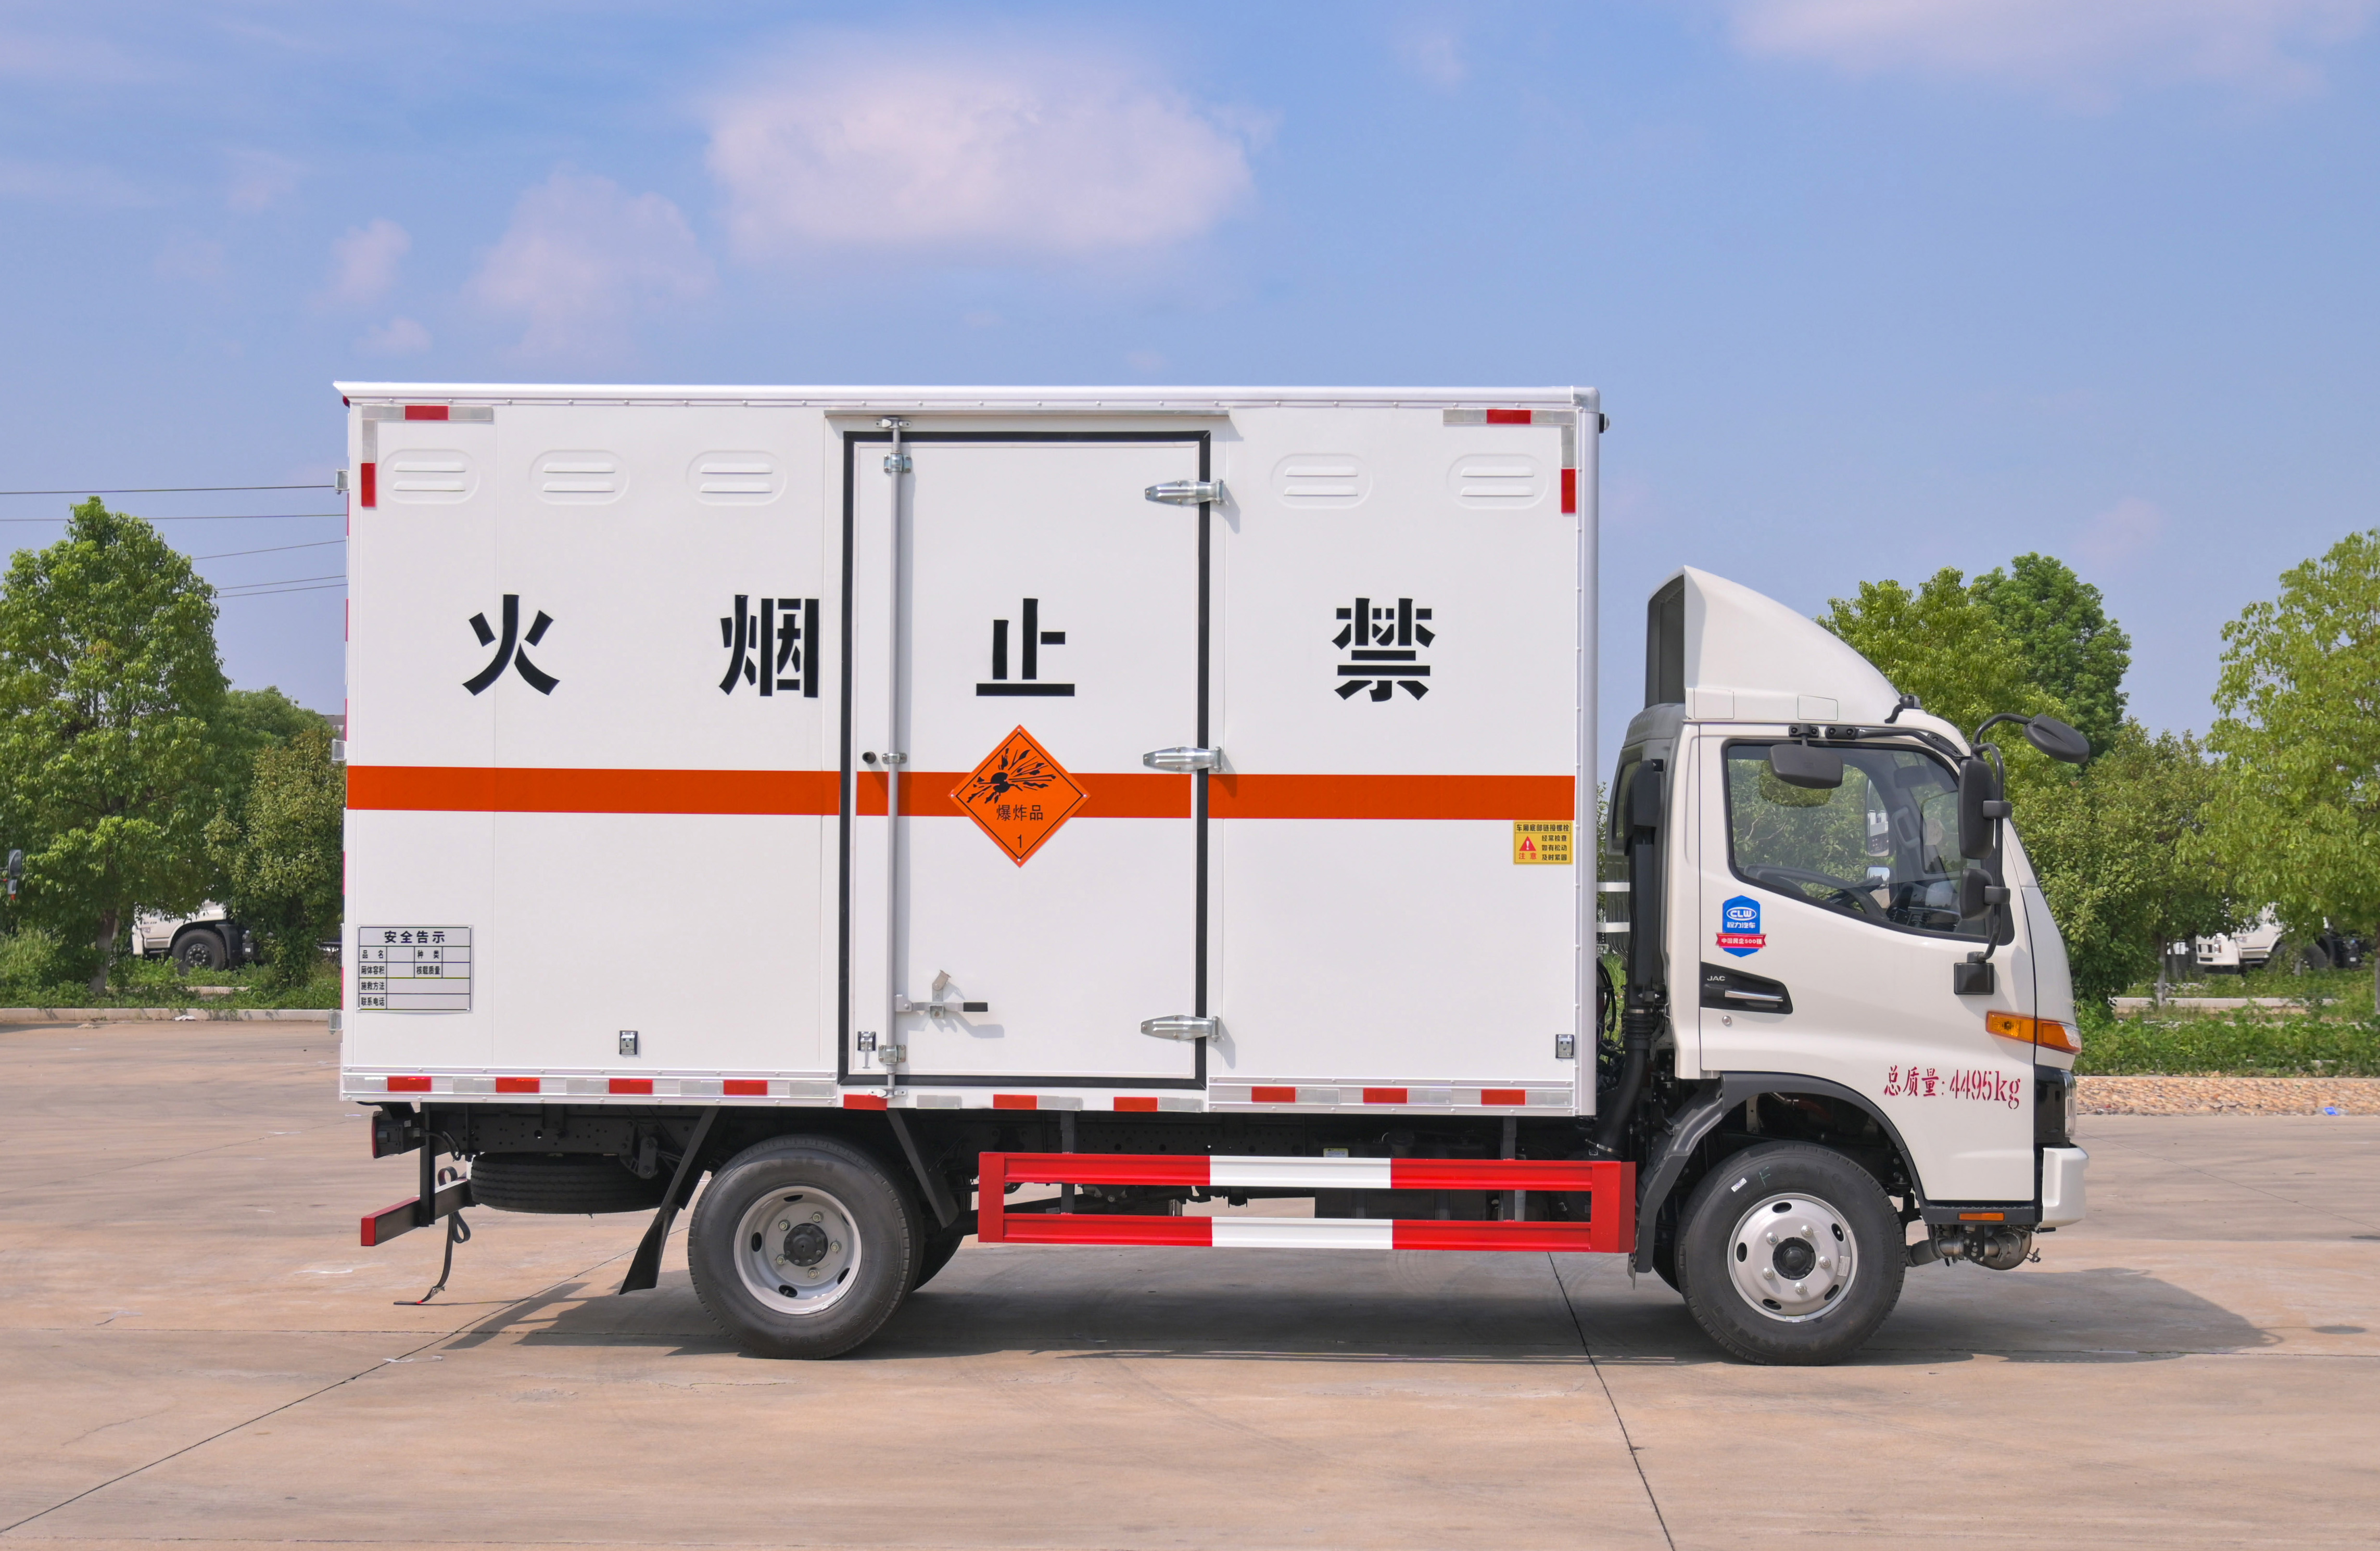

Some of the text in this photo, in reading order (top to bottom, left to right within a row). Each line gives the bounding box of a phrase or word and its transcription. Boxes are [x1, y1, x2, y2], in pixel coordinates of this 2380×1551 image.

[462, 594, 1435, 702] 禁 止 烟 火
[996, 805, 1043, 821] 爆炸品
[1017, 834, 1022, 848] 1
[384, 931, 445, 944] 安全告示
[361, 965, 385, 975] 厢体容积
[416, 965, 440, 975] 核载质量
[361, 981, 385, 990] 施救方法
[361, 997, 385, 1006] 联系电话
